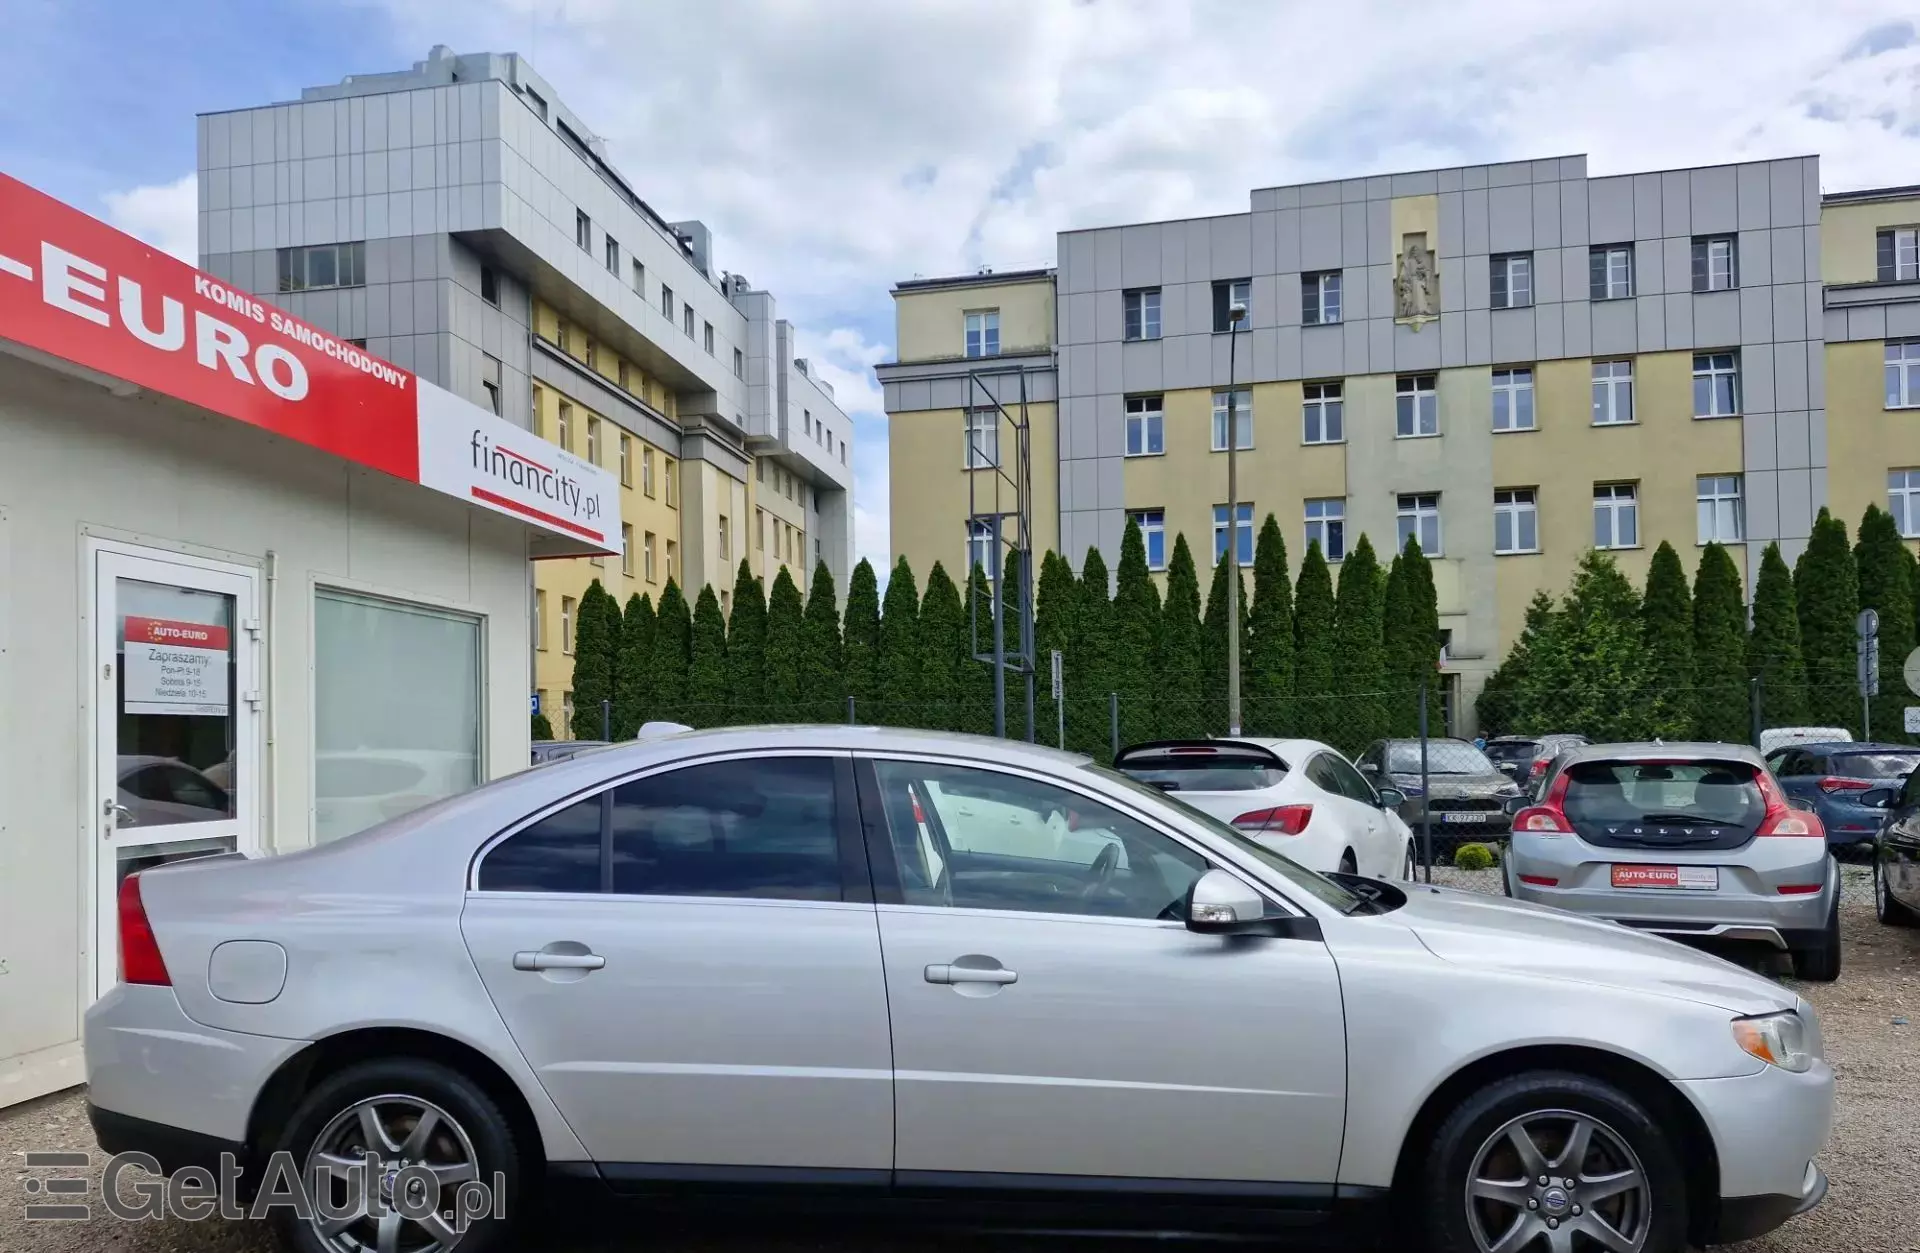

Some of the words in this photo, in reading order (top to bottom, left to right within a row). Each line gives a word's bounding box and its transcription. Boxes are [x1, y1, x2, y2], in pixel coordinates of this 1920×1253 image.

[194, 274, 265, 325] KOMIS
[270, 310, 408, 391] SAMOCHODOWY
[470, 429, 601, 520] financity.pl
[153, 626, 208, 640] AUTO-EURO
[1608, 827, 1720, 836] VOLVO
[1618, 871, 1677, 880] AUTO-EURO
